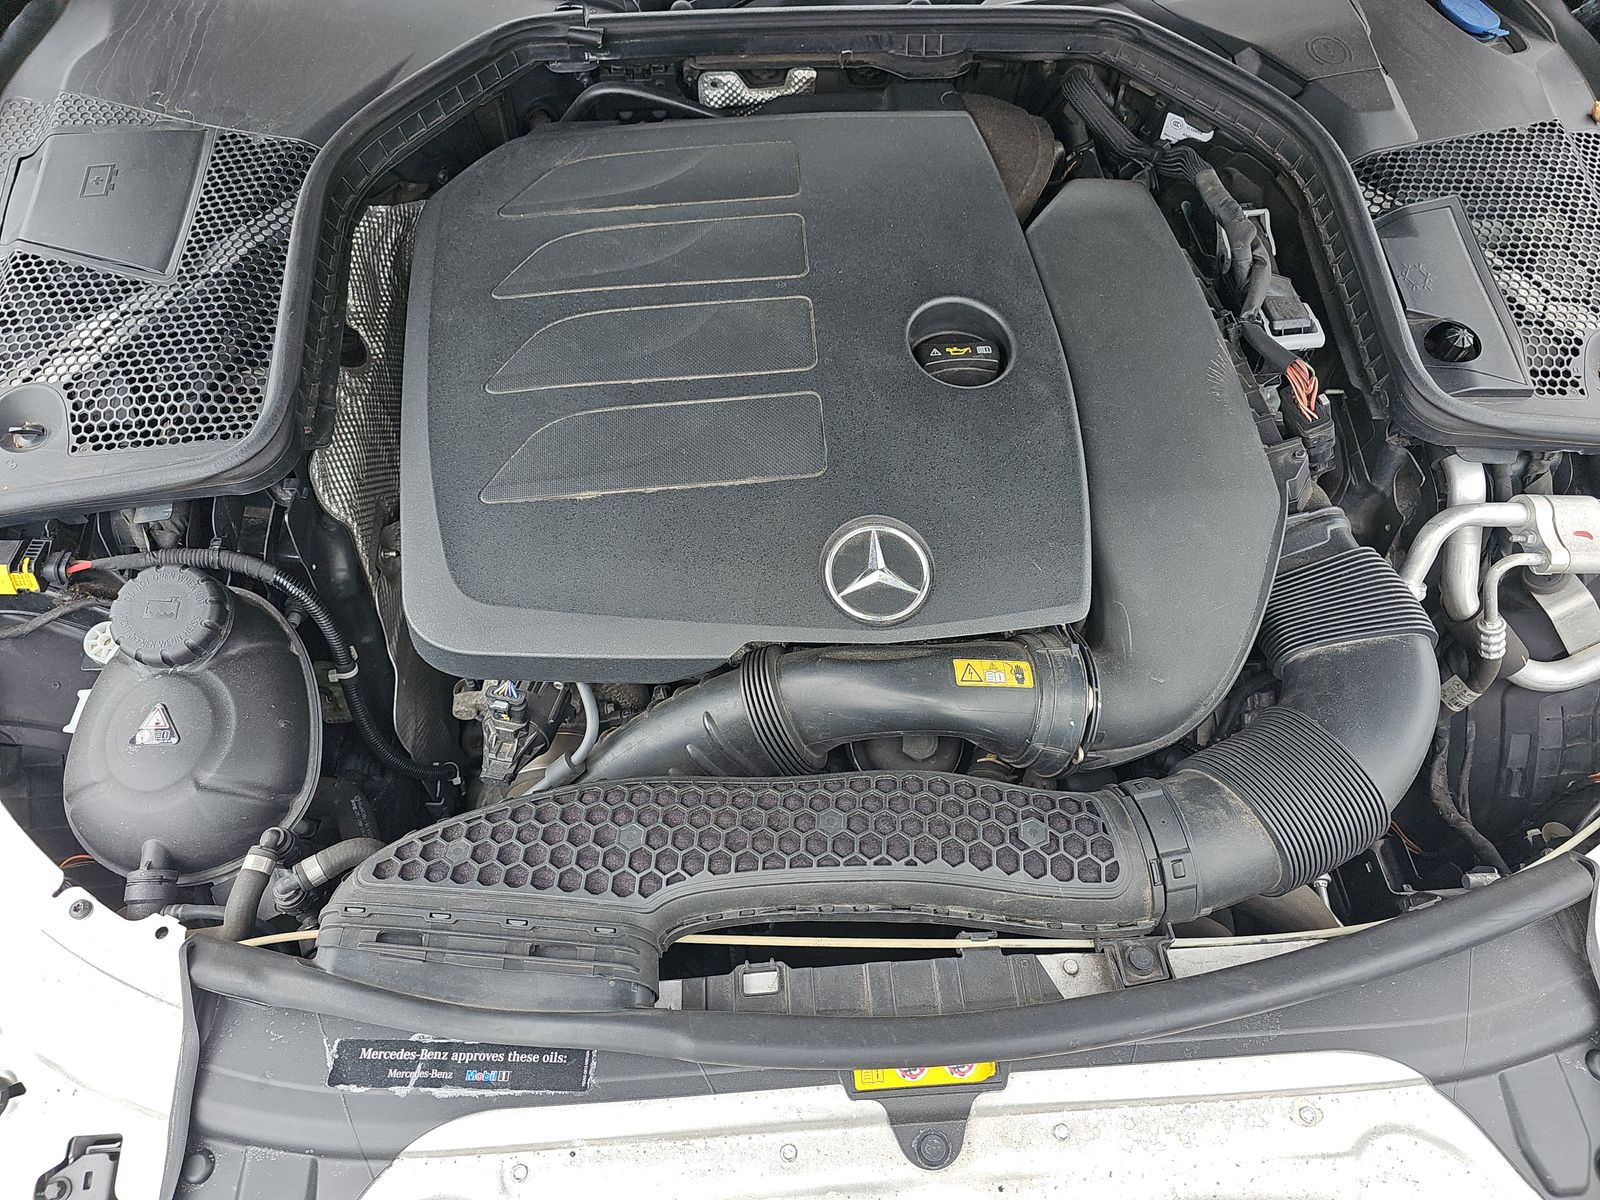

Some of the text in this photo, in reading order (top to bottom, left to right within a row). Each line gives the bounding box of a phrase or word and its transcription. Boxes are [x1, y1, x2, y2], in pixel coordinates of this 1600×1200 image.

[135, 576, 150, 592] NOT
[359, 1047, 568, 1064] Mercedes-Benz approves these oils:
[387, 1068, 454, 1079] Mercedes-Benz
[465, 1069, 498, 1082] Mobil
